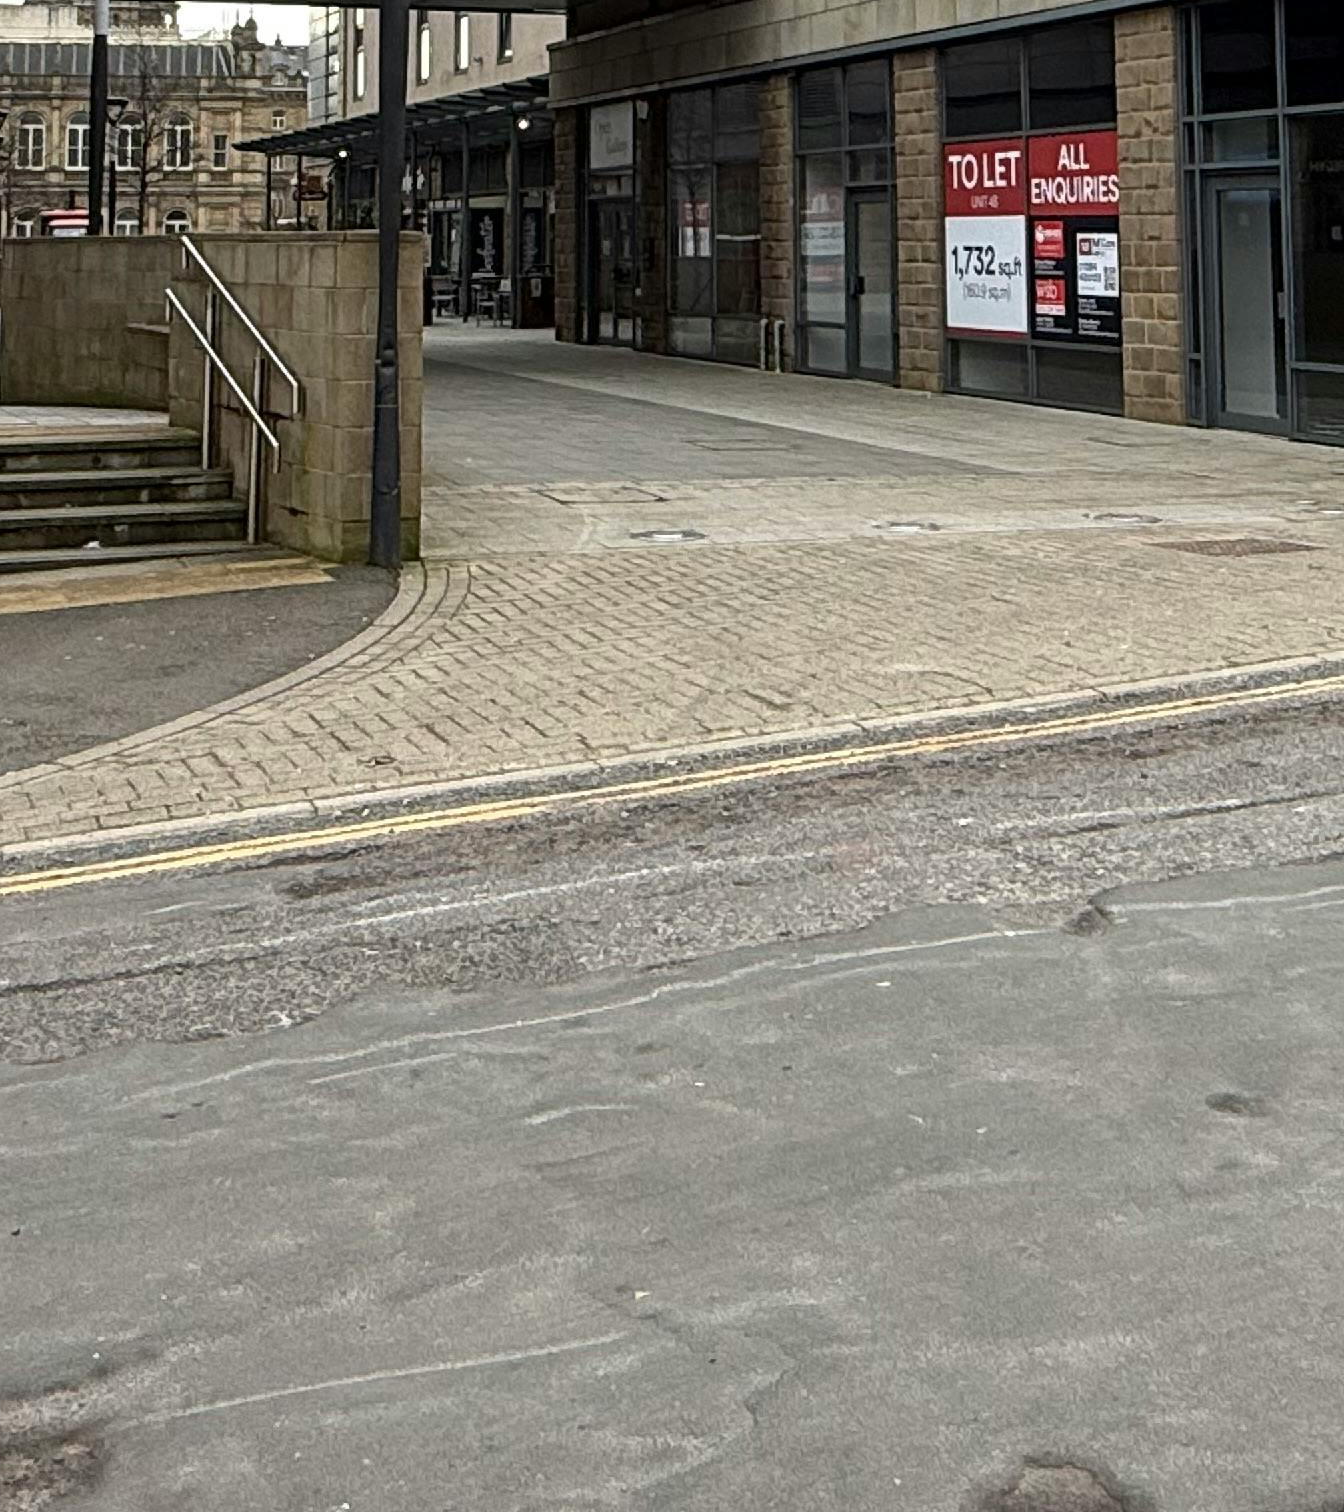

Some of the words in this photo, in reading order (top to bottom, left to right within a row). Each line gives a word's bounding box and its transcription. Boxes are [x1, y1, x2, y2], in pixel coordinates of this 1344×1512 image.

[948, 154, 979, 190] TO
[982, 150, 1022, 188] LET
[1057, 143, 1090, 171] ALL
[1030, 174, 1120, 205] ENQUIRIES
[951, 244, 996, 281] 1,732
